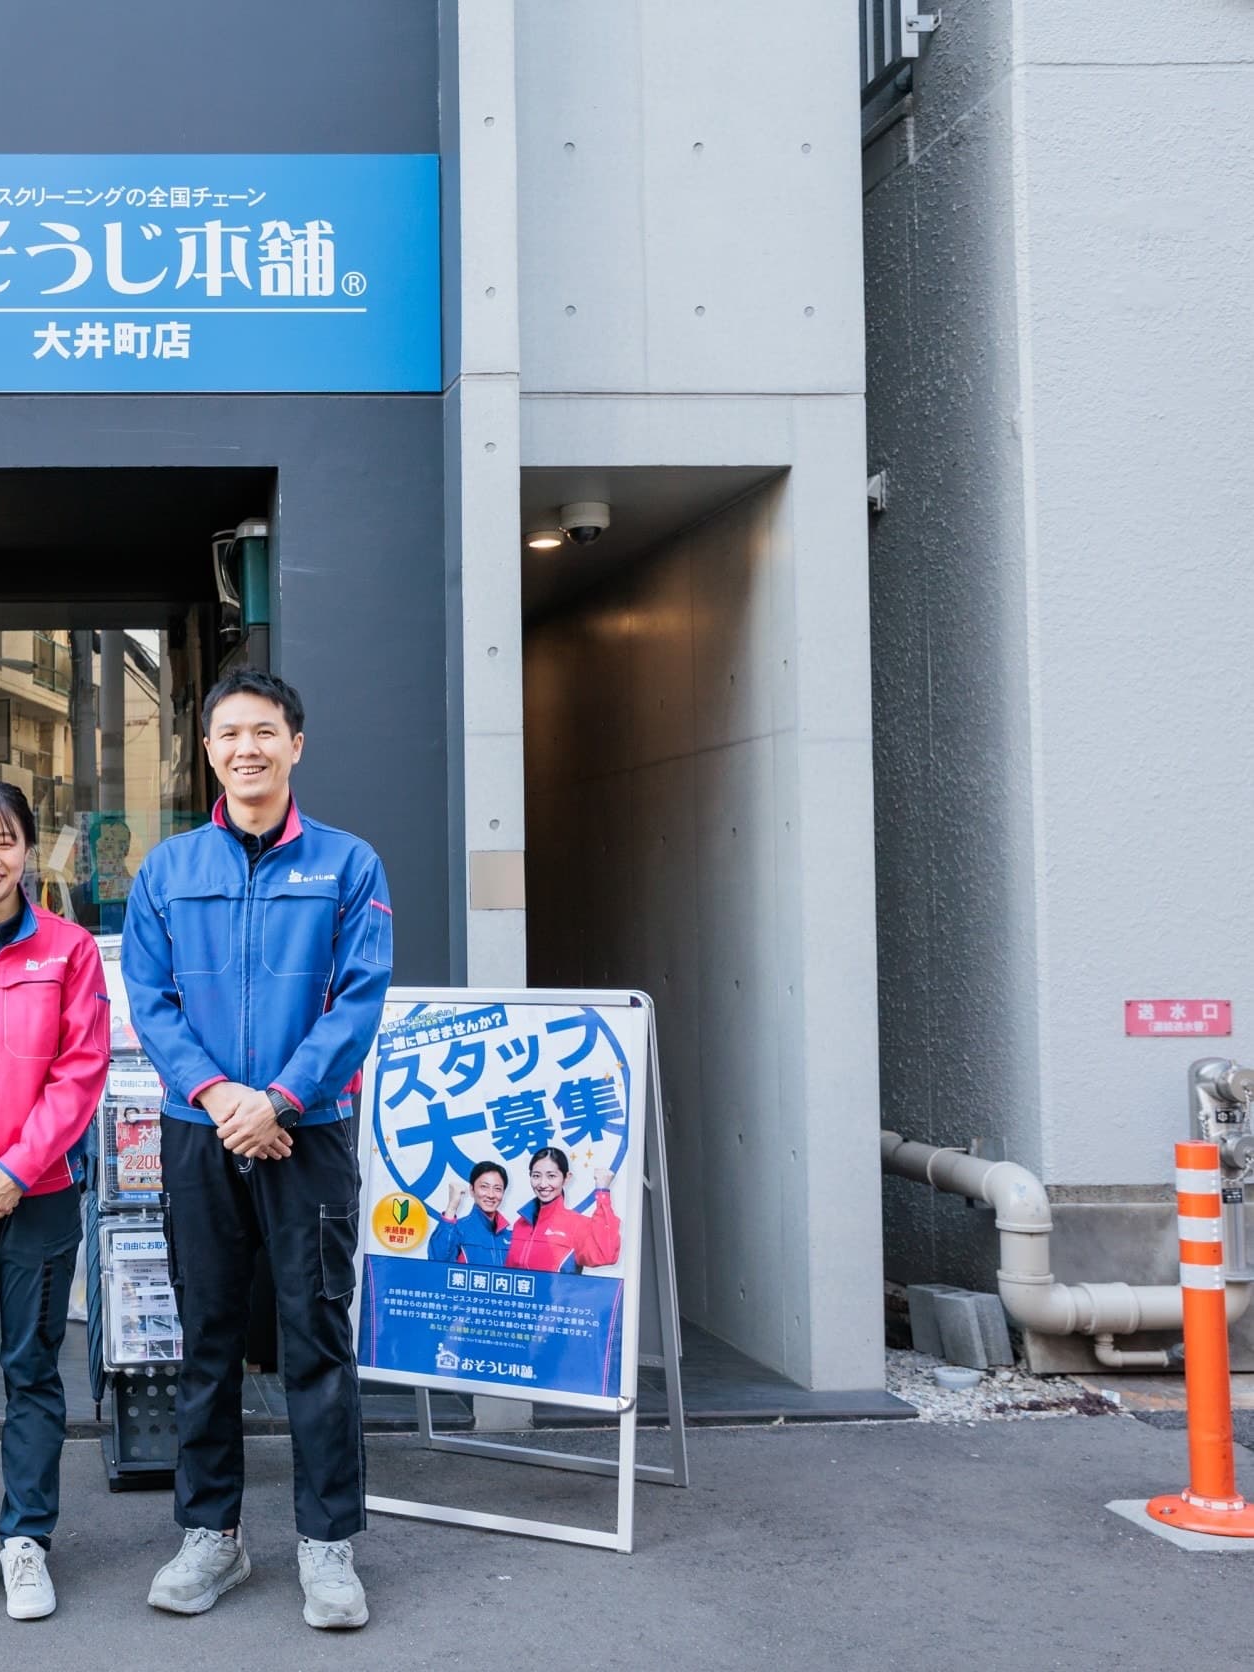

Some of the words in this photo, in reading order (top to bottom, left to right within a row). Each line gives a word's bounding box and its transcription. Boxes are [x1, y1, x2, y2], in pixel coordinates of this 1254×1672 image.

[32, 321, 191, 358] 大井町店
[379, 1006, 598, 1110] スタッフ
[394, 1076, 625, 1198] 大募集
[451, 1272, 531, 1293] 業務内容
